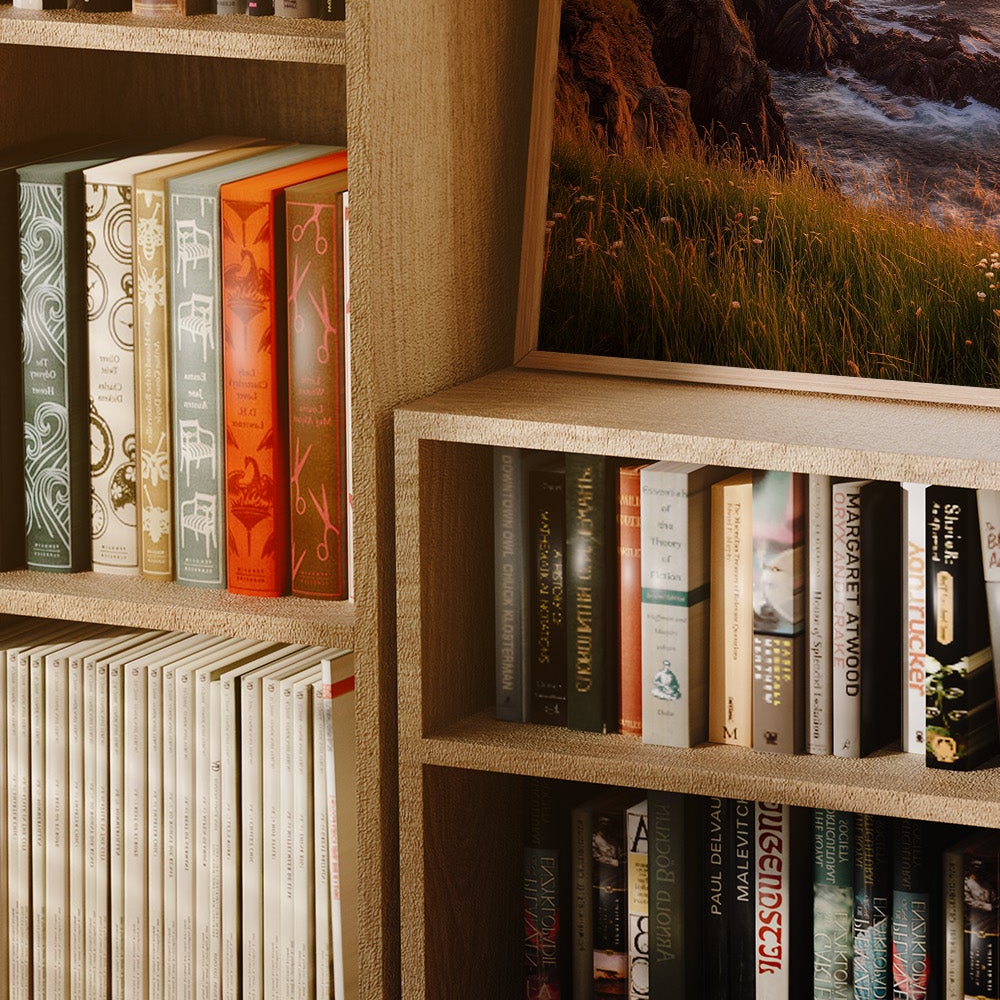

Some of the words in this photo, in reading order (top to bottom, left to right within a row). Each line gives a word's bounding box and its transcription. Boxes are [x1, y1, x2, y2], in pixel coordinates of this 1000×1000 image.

[502, 453, 514, 528] DOWNTOWN
[660, 504, 671, 513] of
[658, 521, 674, 530] the
[834, 491, 846, 545] ORYX
[502, 531, 514, 558] OWL
[651, 537, 682, 550] Theory
[661, 554, 672, 563] of
[845, 492, 861, 606] MARGARET
[502, 562, 514, 607] CHUCK
[650, 570, 682, 582] Fiction
[834, 550, 846, 593] AND
[812, 589, 823, 624] House
[502, 609, 514, 692] KLOSTERMAN
[834, 600, 847, 668] CRAKE
[845, 611, 861, 696] ATWOOD
[908, 605, 926, 697] rucker
[811, 640, 824, 689] Splendid
[722, 725, 739, 741] M
[710, 798, 722, 866] DELVAU
[710, 871, 723, 916] PAUL
